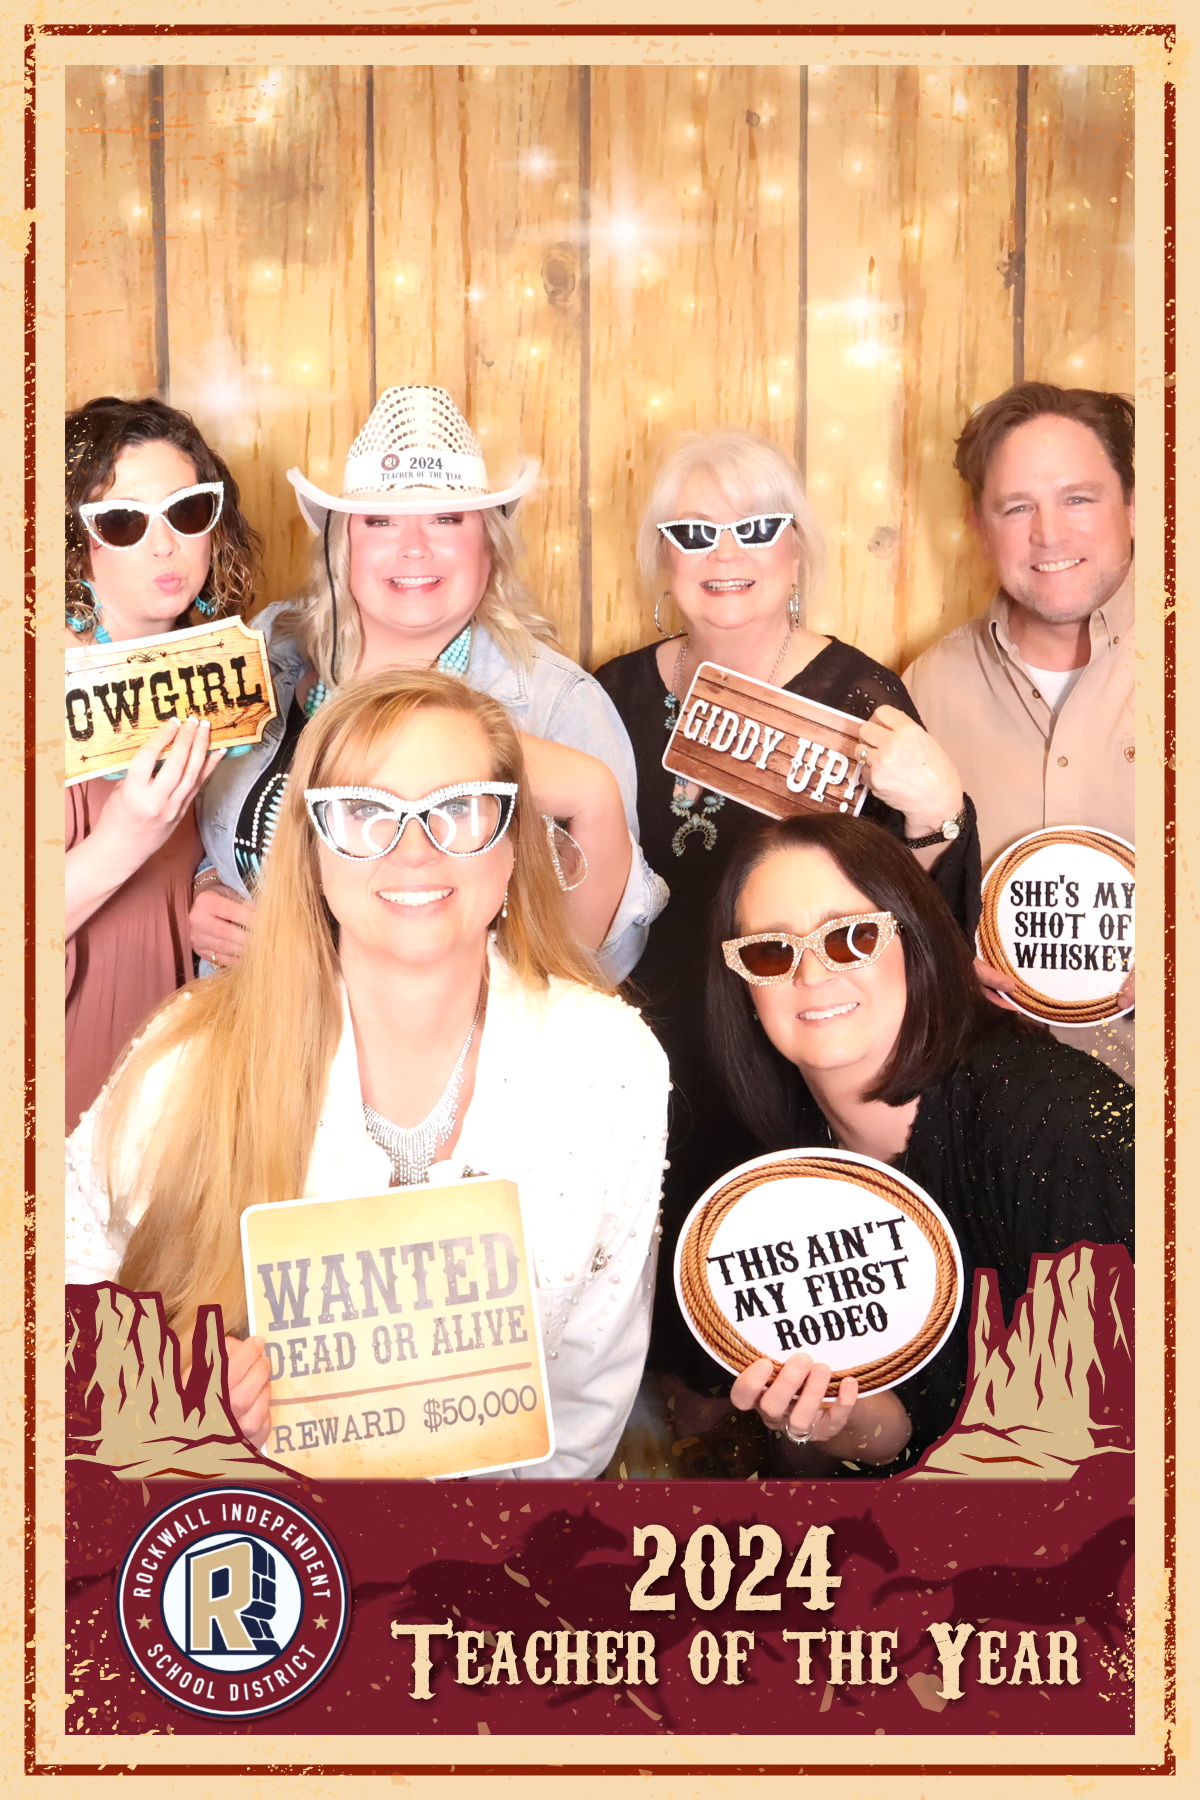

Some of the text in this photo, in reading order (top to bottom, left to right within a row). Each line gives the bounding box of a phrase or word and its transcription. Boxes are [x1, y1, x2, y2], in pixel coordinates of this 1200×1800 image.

[409, 457, 443, 470] 2024
[65, 655, 263, 742] OWGIRL
[683, 699, 864, 813] GIDDY UP!
[1010, 874, 1135, 909] SHE'S MY
[1014, 911, 1132, 941] SHOT OF
[1013, 942, 1133, 973] WHISKEY
[256, 1231, 520, 1332] WANTED
[706, 1215, 906, 1286] THIS AIN'T
[733, 1254, 909, 1323] MY FIRST
[264, 1304, 529, 1382] DEAD OR ALIVE
[773, 1301, 889, 1351] RODEO
[272, 1384, 538, 1454] REWARD $50,000
